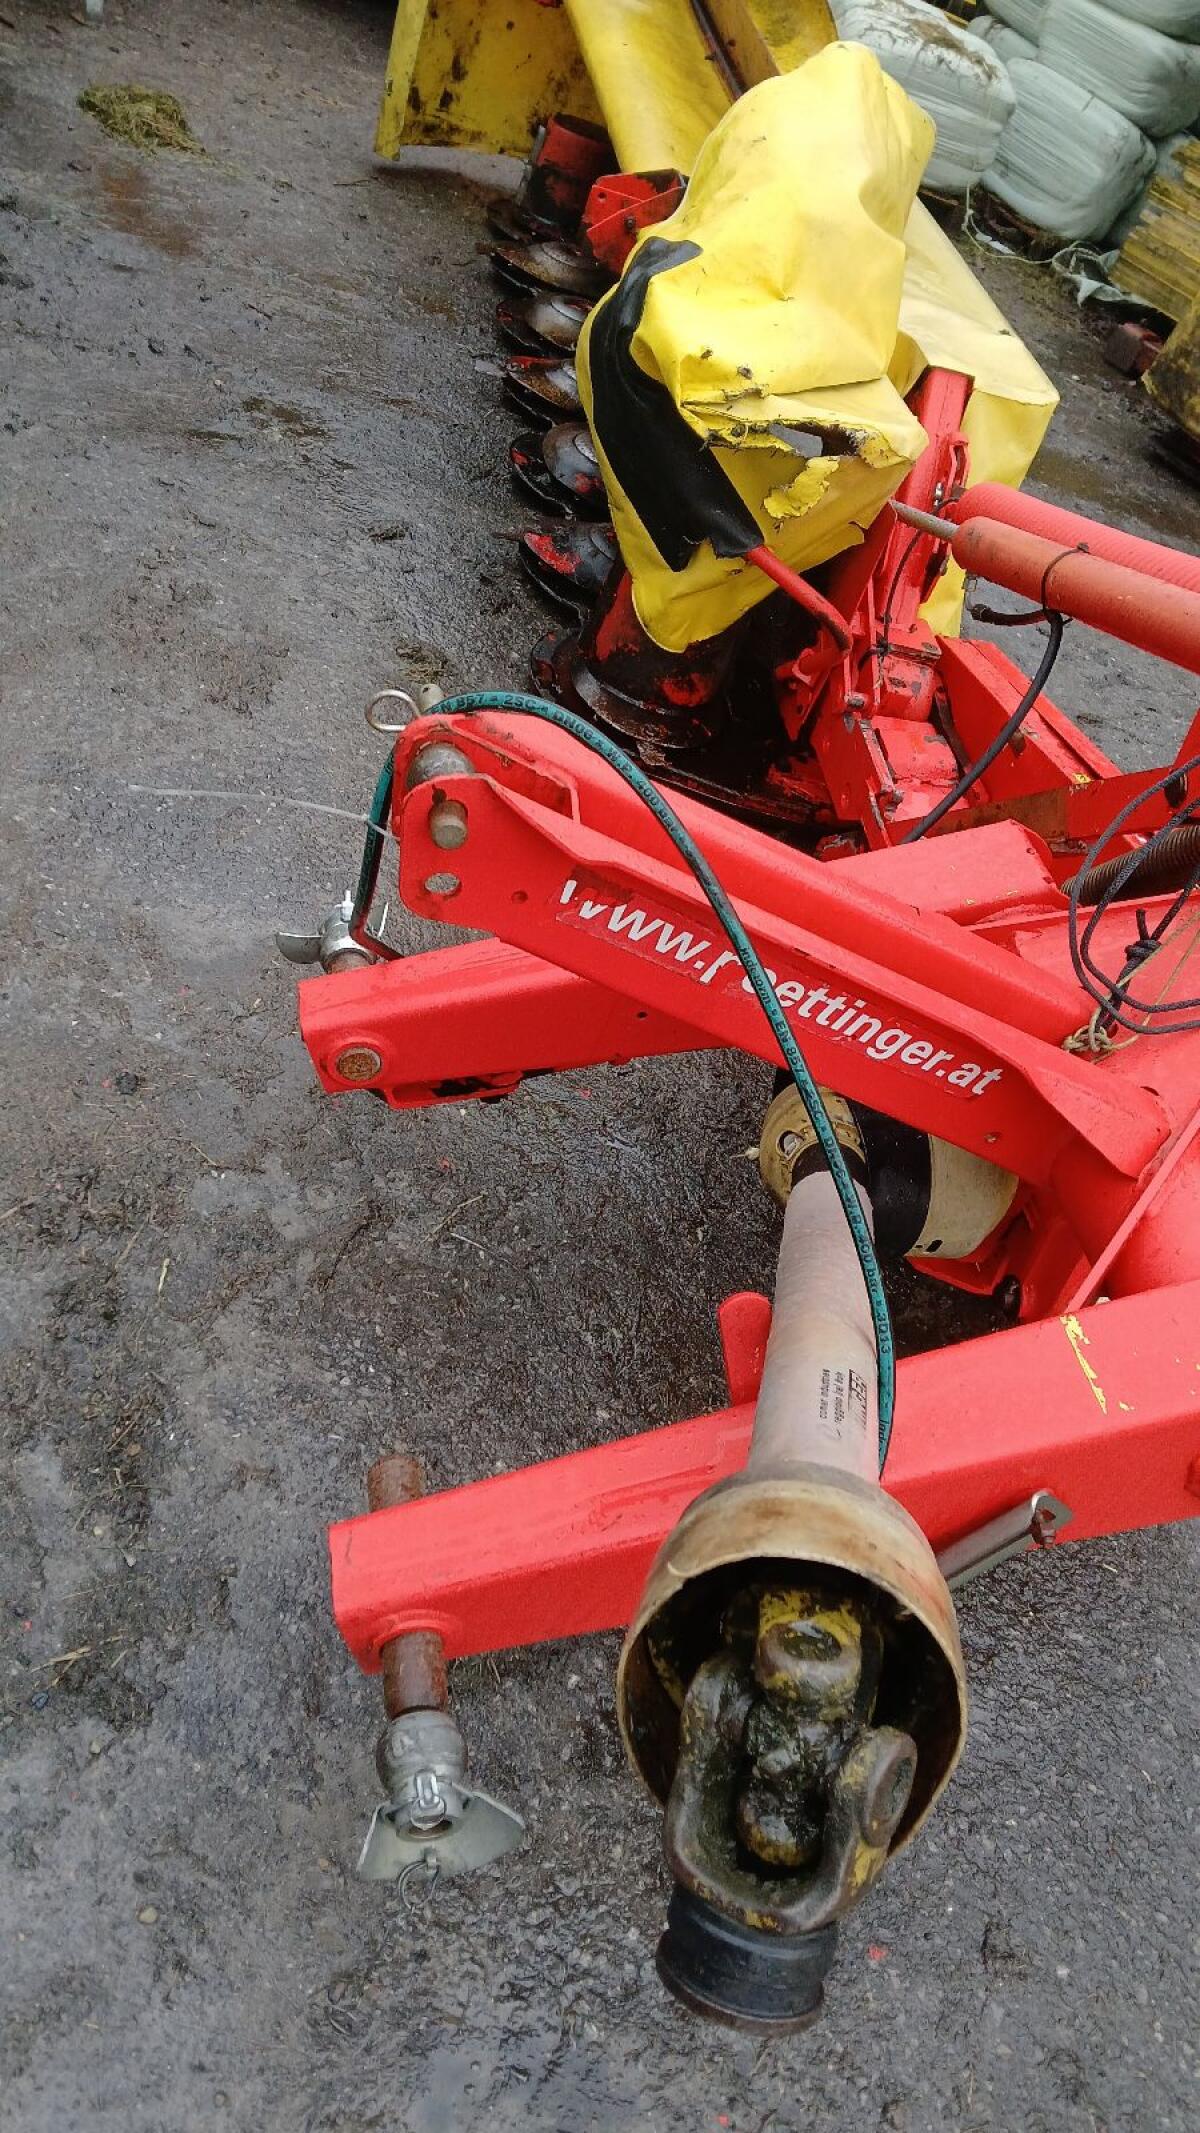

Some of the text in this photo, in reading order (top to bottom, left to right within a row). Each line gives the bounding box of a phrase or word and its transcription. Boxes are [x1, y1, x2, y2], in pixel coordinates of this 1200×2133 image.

[552, 712, 593, 740] DN06
[637, 781, 660, 806] 400
[774, 1020, 792, 1043] EN
[787, 1045, 805, 1073] 857
[866, 1268, 879, 1293] bar
